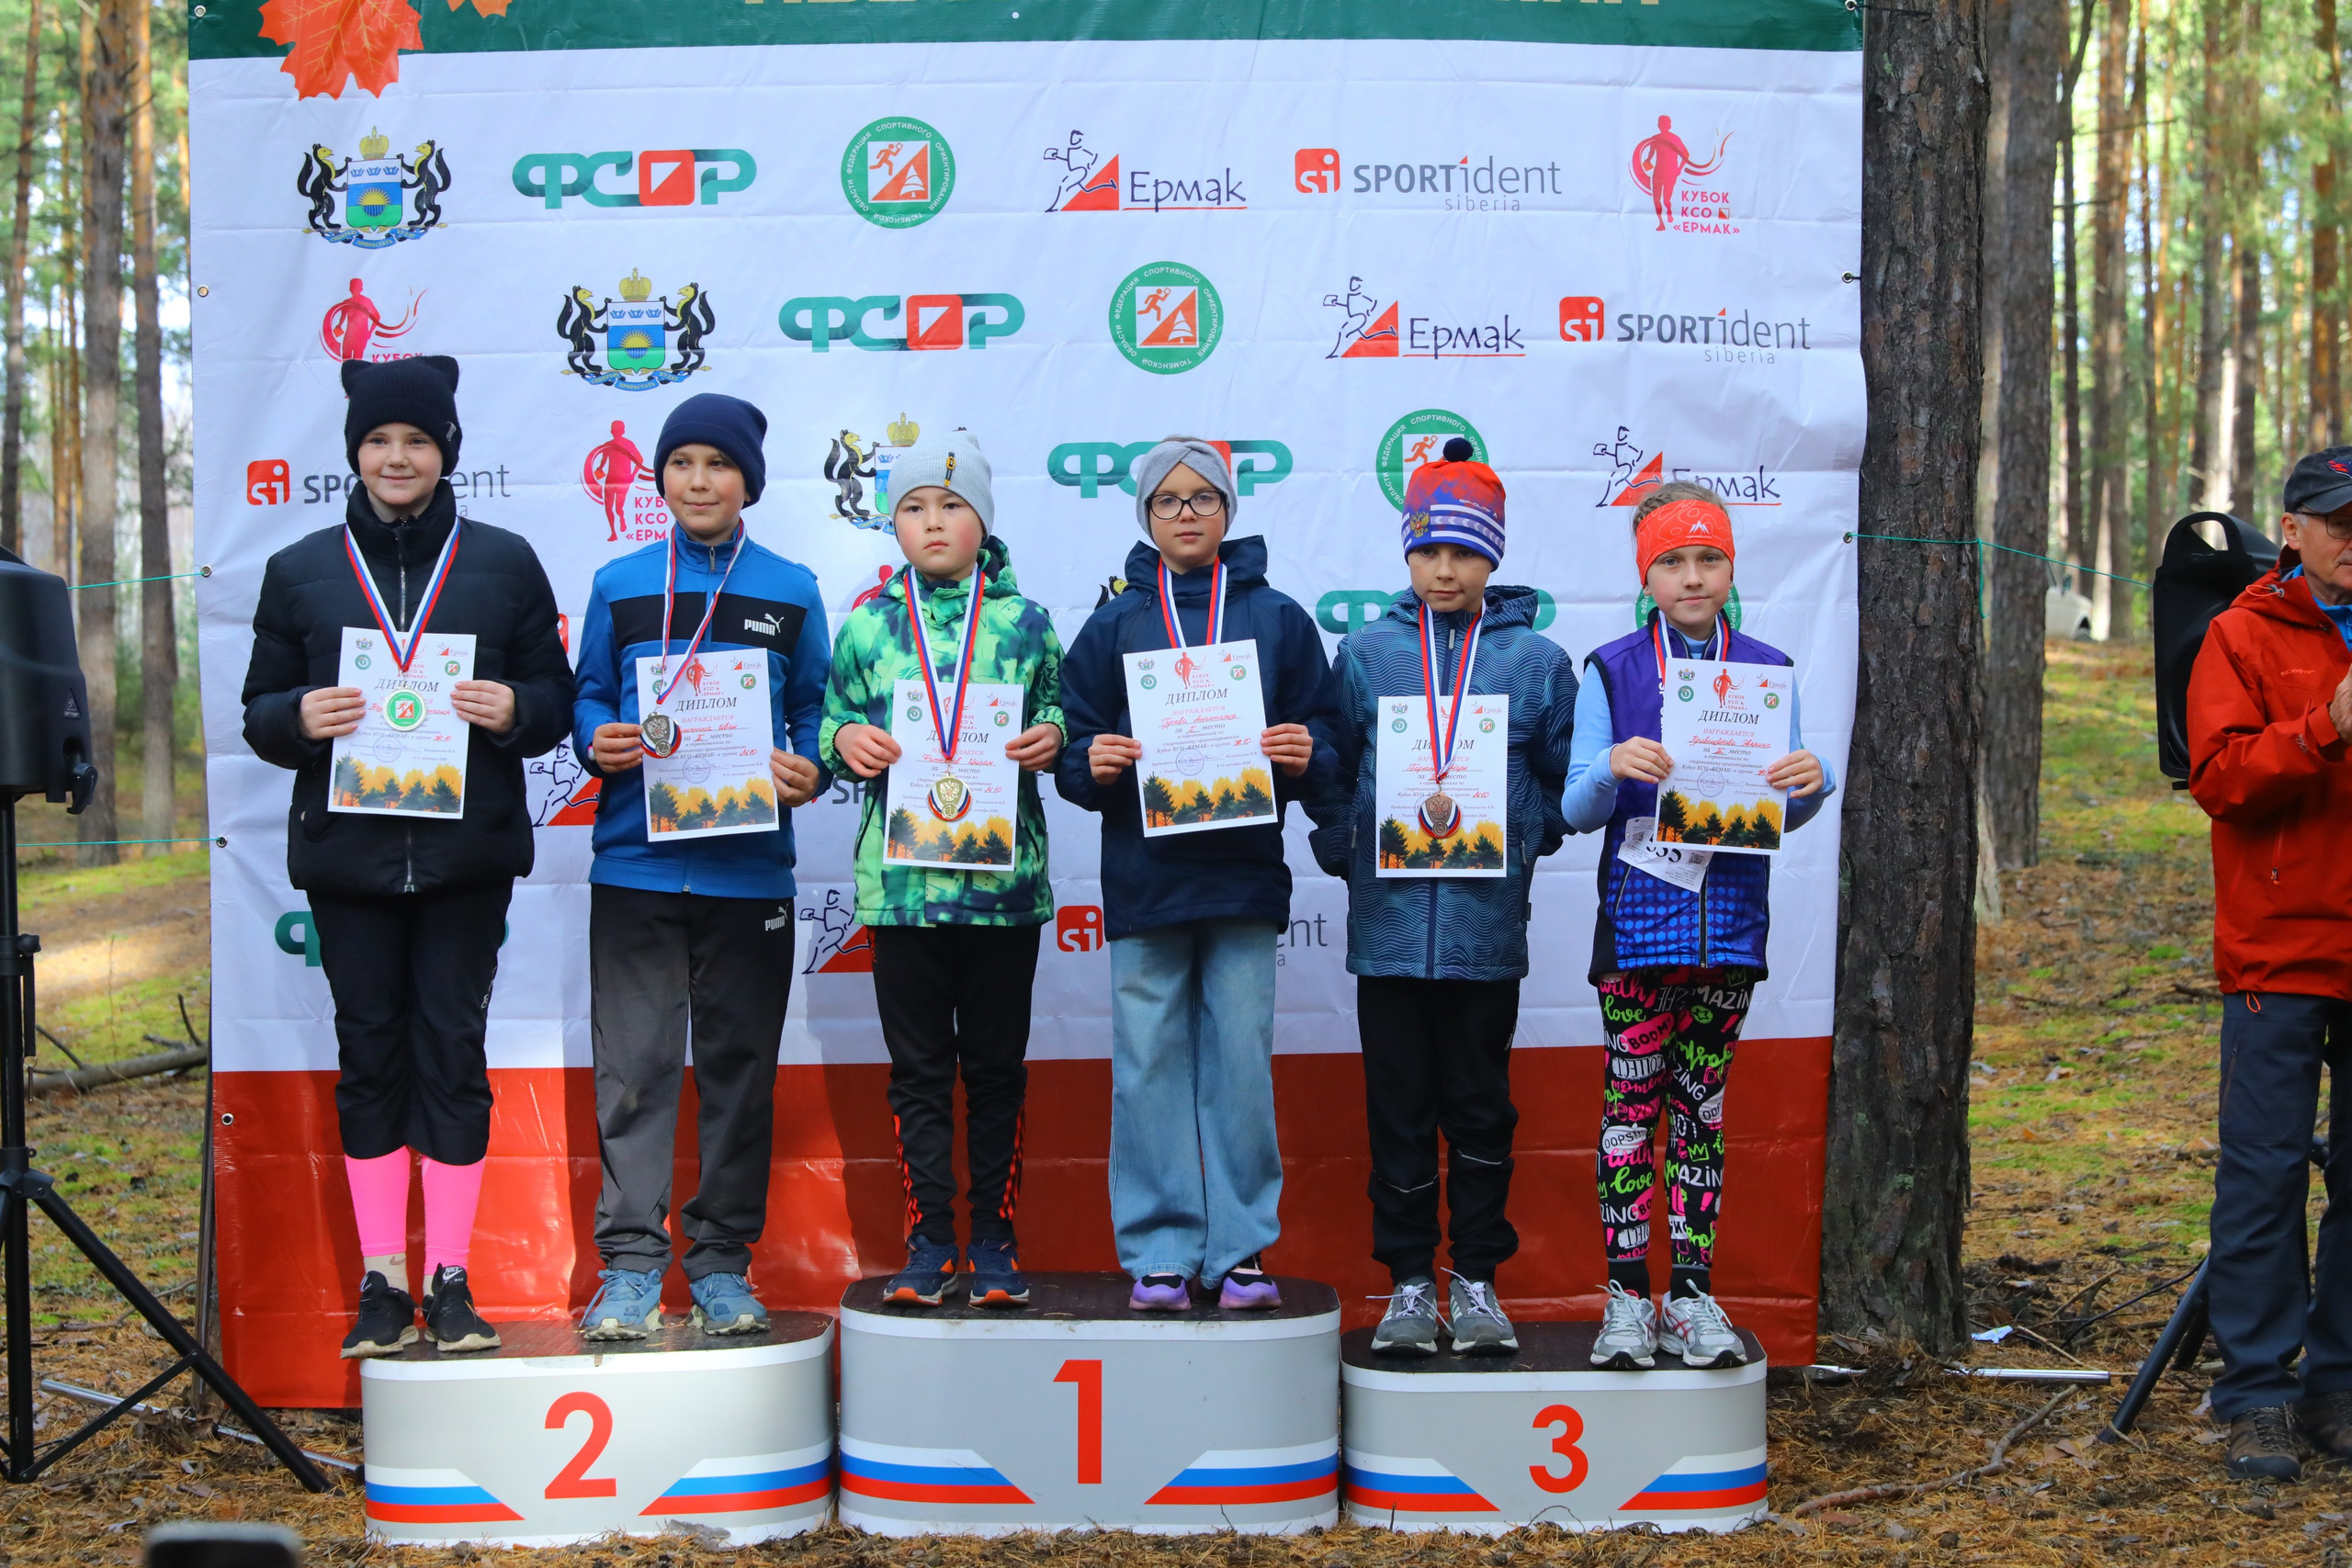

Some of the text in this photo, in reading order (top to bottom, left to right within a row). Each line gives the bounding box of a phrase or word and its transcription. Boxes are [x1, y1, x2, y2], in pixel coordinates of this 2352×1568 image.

[846, 122, 950, 223] ФЕДЕРАЦИЯ СПОРТИВНОГО ОРИЕНТИРОВАНИЯ ТЮМЕНСКОЙ ОБЛАСТИ
[1353, 154, 1562, 195] SPORTident
[1130, 168, 1247, 211] Ермак
[1680, 190, 1729, 204] КУБОК
[1444, 194, 1521, 212] siberia
[1680, 207, 1713, 219] КСО
[1672, 221, 1741, 235] «ЕРМАК»
[1114, 266, 1218, 369] ФЕДЕРАЦИЯ СПОРТИВНОГО ОРИЕНТИРОВАНИЯ ТЮМЕНСКОЙ ОБЛАСТИ
[1409, 315, 1525, 359] Ермак
[1617, 307, 1811, 351] SPORTident
[1703, 347, 1776, 365] siberia
[1382, 414, 1466, 505] ФЕДЕРАЦИЯ СПОРТИВНОГО ОБЛАСТИ
[635, 496, 669, 508] КУБ
[635, 513, 668, 525] КСО
[626, 529, 666, 541] «ЕРМ
[744, 618, 775, 637] PUMA
[674, 697, 737, 713] ДИПЛОМ
[1165, 688, 1227, 706] ДИПЛОМ
[682, 715, 734, 723] НАГРАЖДАЕТСЯ
[1172, 705, 1226, 716] НАГРАЖДАЕТСЯ
[1698, 710, 1759, 725] ДИПЛОМ
[926, 729, 989, 743] ДЛОМ
[1703, 728, 1755, 737] НАГРАЖДАЕТСЯ
[765, 915, 786, 931] PUMA
[1604, 995, 1646, 1022] love
[1602, 1147, 1652, 1168] with
[1611, 1167, 1654, 1194] love
[1053, 1359, 1102, 1484] 1
[544, 1391, 616, 1500] 2
[1529, 1404, 1589, 1494] 3
